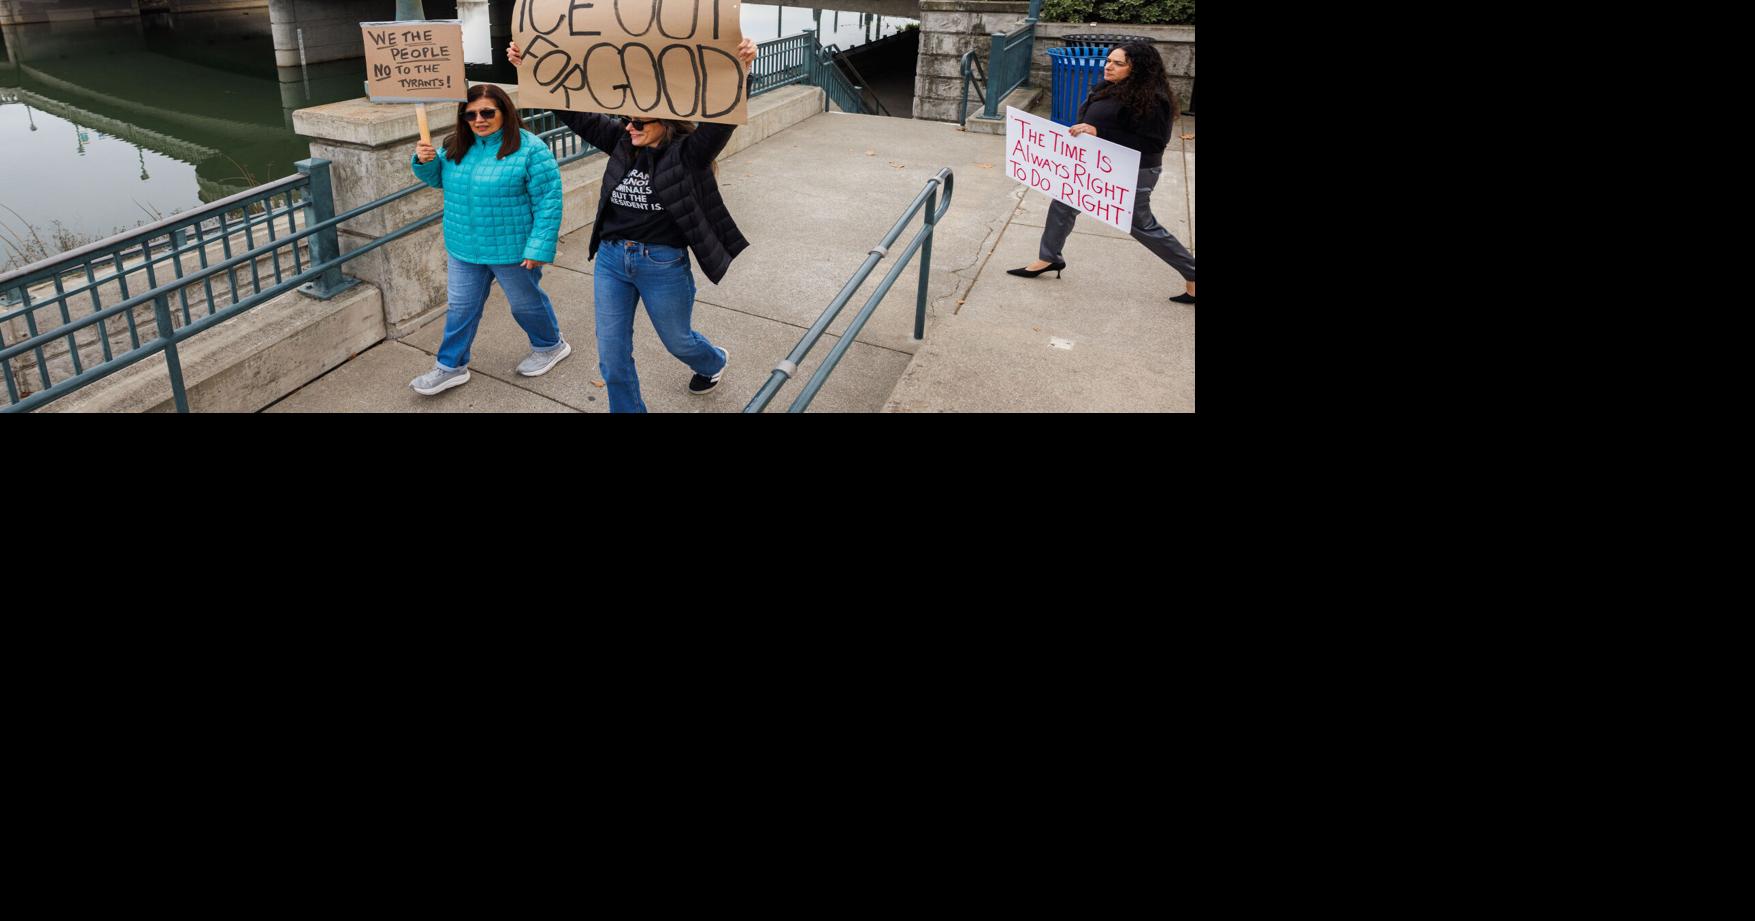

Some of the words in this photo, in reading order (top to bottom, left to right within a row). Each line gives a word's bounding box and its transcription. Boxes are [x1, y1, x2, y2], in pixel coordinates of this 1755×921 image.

[367, 30, 397, 46] WE
[401, 29, 433, 43] THE
[390, 45, 451, 60] PEOPLE
[373, 63, 392, 78] NO
[394, 64, 411, 75] TO
[414, 63, 440, 74] THE
[520, 35, 586, 108] FOR
[583, 41, 744, 118] GOOD
[398, 75, 451, 88] TYRANTS!
[1096, 149, 1113, 174] IS
[1009, 159, 1027, 181] TO
[1031, 168, 1051, 191] DO
[1061, 182, 1125, 225] RIGHT
[1073, 163, 1130, 205] RIGHT
[611, 190, 627, 200] BUT
[629, 193, 647, 203] THE
